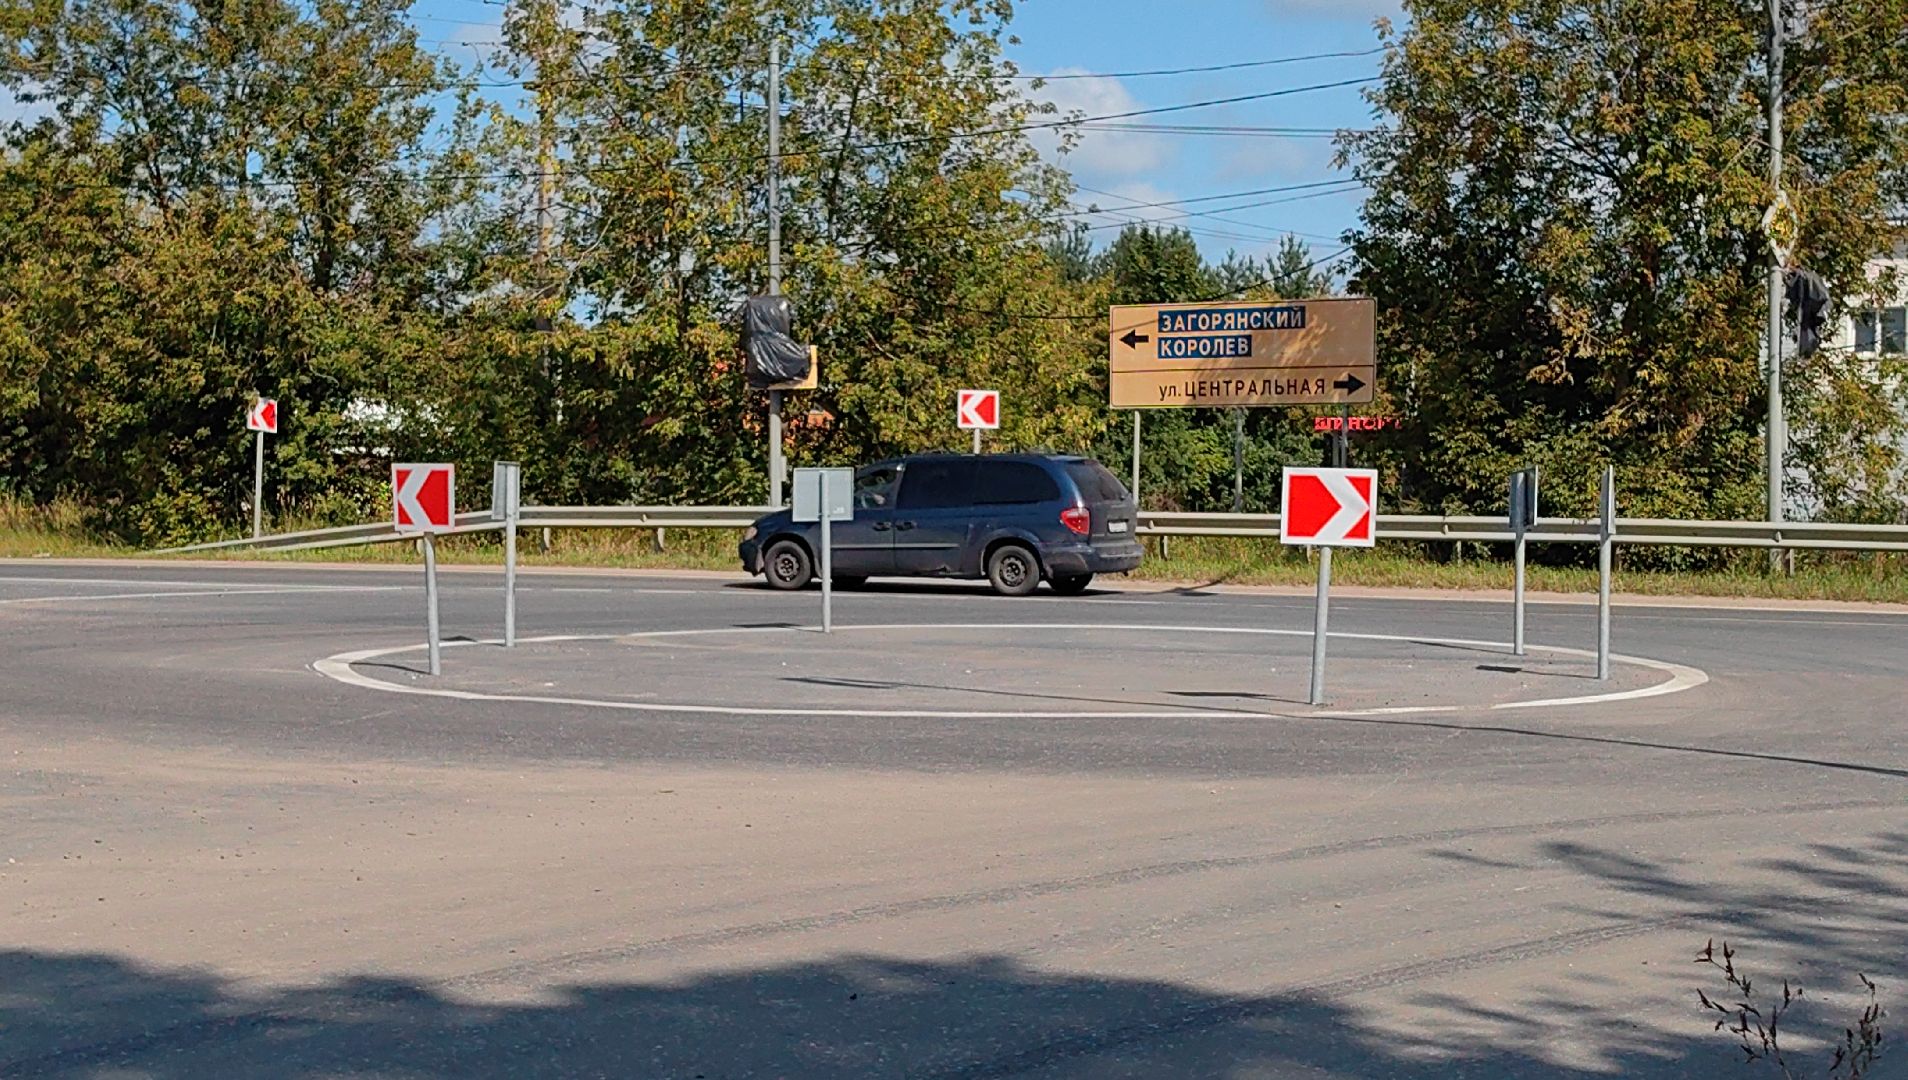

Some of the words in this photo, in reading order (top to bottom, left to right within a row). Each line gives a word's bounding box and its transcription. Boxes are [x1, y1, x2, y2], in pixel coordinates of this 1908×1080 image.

[1160, 306, 1303, 332] ЗАГОРЯНСКИЙ
[1160, 338, 1250, 357] КОРОЛЕВ
[1159, 382, 1182, 401] ул.
[1185, 378, 1325, 400] ЦЕНТРАЛЬНАЯ
